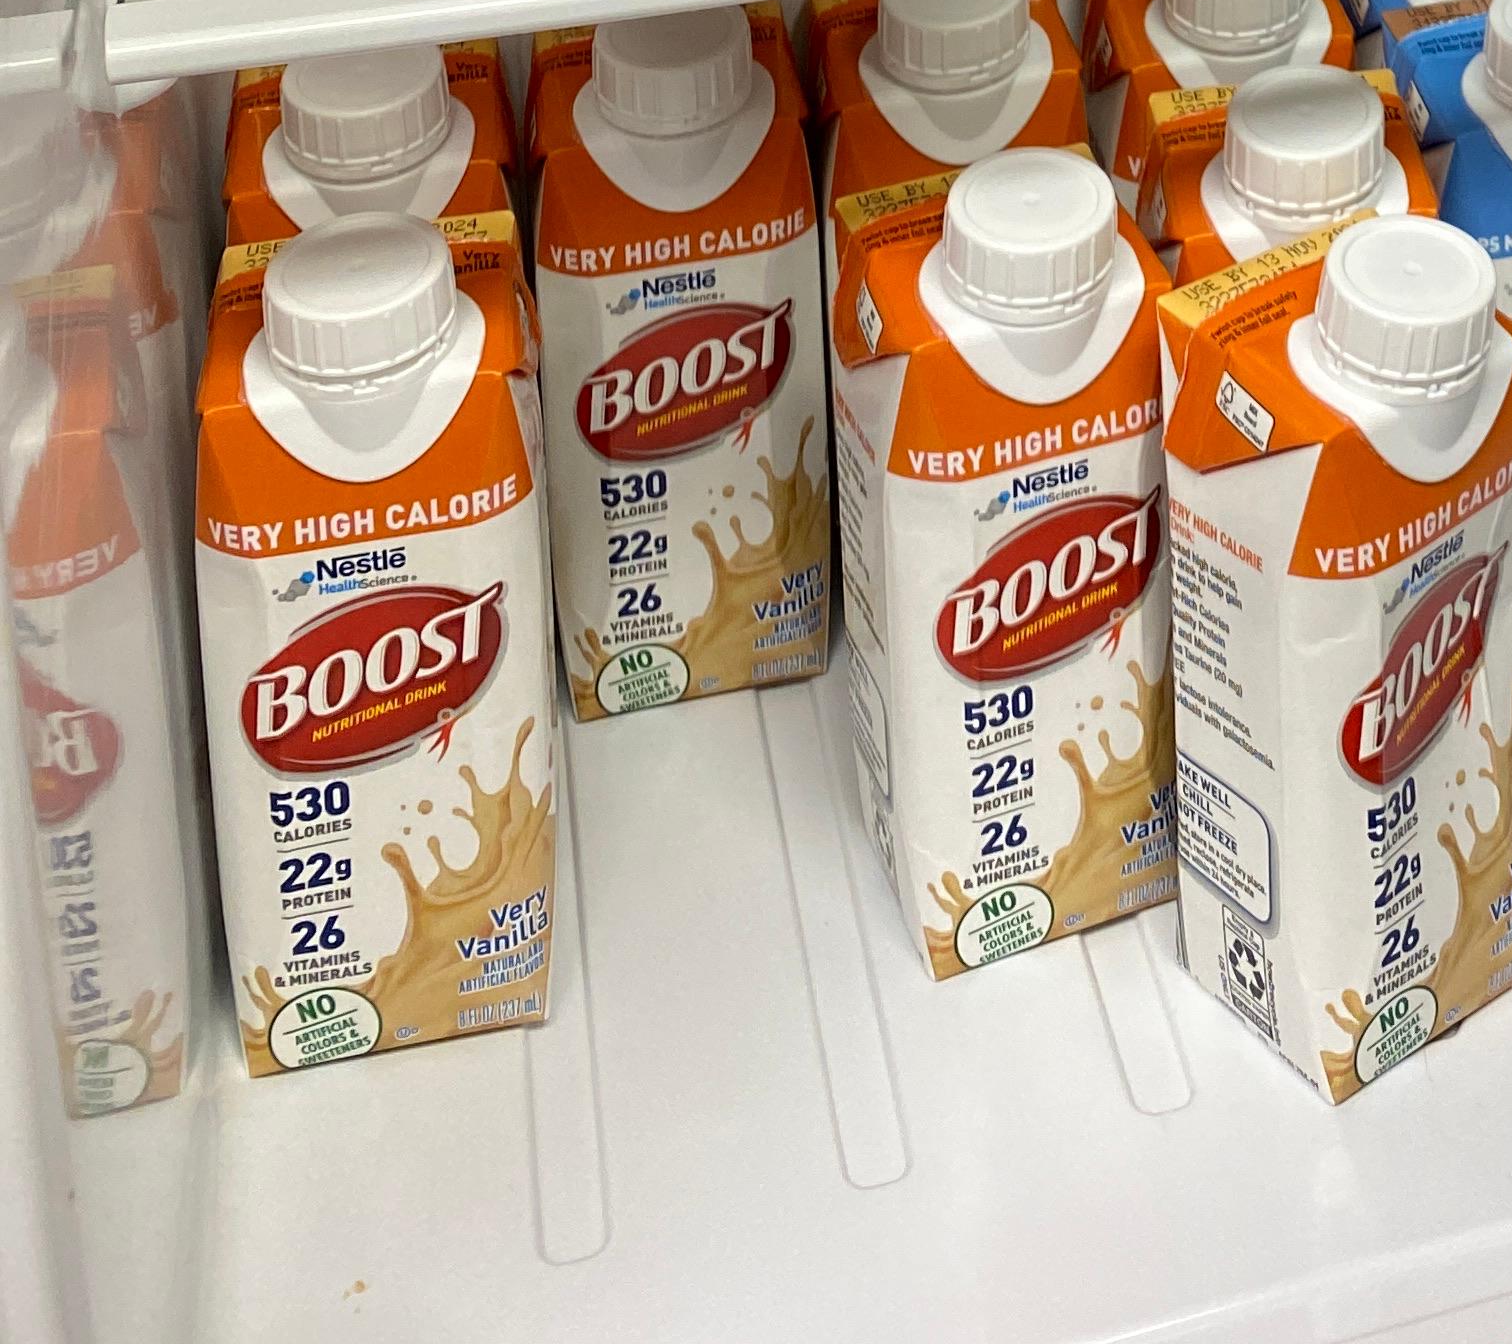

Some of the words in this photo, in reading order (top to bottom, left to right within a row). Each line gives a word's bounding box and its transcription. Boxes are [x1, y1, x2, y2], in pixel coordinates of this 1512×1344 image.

[1172, 87, 1204, 105] USE
[902, 180, 926, 198] BY
[550, 242, 616, 273] VERY
[624, 234, 692, 267] HIGH
[699, 206, 806, 255] CALORIE
[1180, 280, 1223, 302] USE
[1222, 266, 1250, 284] BY
[582, 297, 793, 435] BOOST
[906, 444, 986, 477] VERY
[993, 424, 1064, 464] HIGH
[1070, 398, 1160, 446] CALOR
[207, 516, 284, 553] VERY
[294, 506, 376, 546] HIGH
[385, 472, 518, 532] CALORIE
[1013, 484, 1091, 514] HealthScience
[1192, 512, 1219, 543] HIGH
[1220, 531, 1264, 575] CALORIE
[1314, 532, 1391, 575] VERY
[1398, 500, 1452, 555] HIGH
[318, 573, 409, 596] HealthScience
[780, 559, 824, 597] Very
[948, 484, 1162, 657] BOOST
[753, 579, 825, 622] Vanilla
[1002, 603, 1080, 652] NUTRITIONAL
[1080, 582, 1120, 610] DRINK
[248, 581, 503, 742] BOOST
[1353, 539, 1510, 764] BOOST
[311, 697, 402, 743] NUTRITIONAL
[404, 680, 448, 706] DRINK
[963, 684, 1035, 736] 530
[966, 720, 1036, 752] CALORIES
[971, 754, 1035, 799] 22g
[1199, 775, 1233, 810] WELL
[269, 780, 351, 828] 530
[972, 786, 1035, 816] PROTEIN
[1182, 782, 1214, 818] CHILL
[273, 818, 353, 844] CALORIES
[980, 813, 1029, 857] 26
[1197, 812, 1239, 858] FREEZE
[277, 851, 353, 895] 22g
[281, 886, 352, 911] PROTEIN
[490, 885, 548, 929] Very
[980, 890, 1018, 923] NO
[290, 914, 346, 957] 26
[457, 910, 549, 960] Vanilla
[274, 976, 287, 988] &
[289, 961, 373, 987] MINERALS
[282, 950, 361, 973] VITAMINS
[294, 992, 337, 1024] NO
[294, 1016, 358, 1047] ARTIFICIAL
[300, 1033, 348, 1055] COLORS
